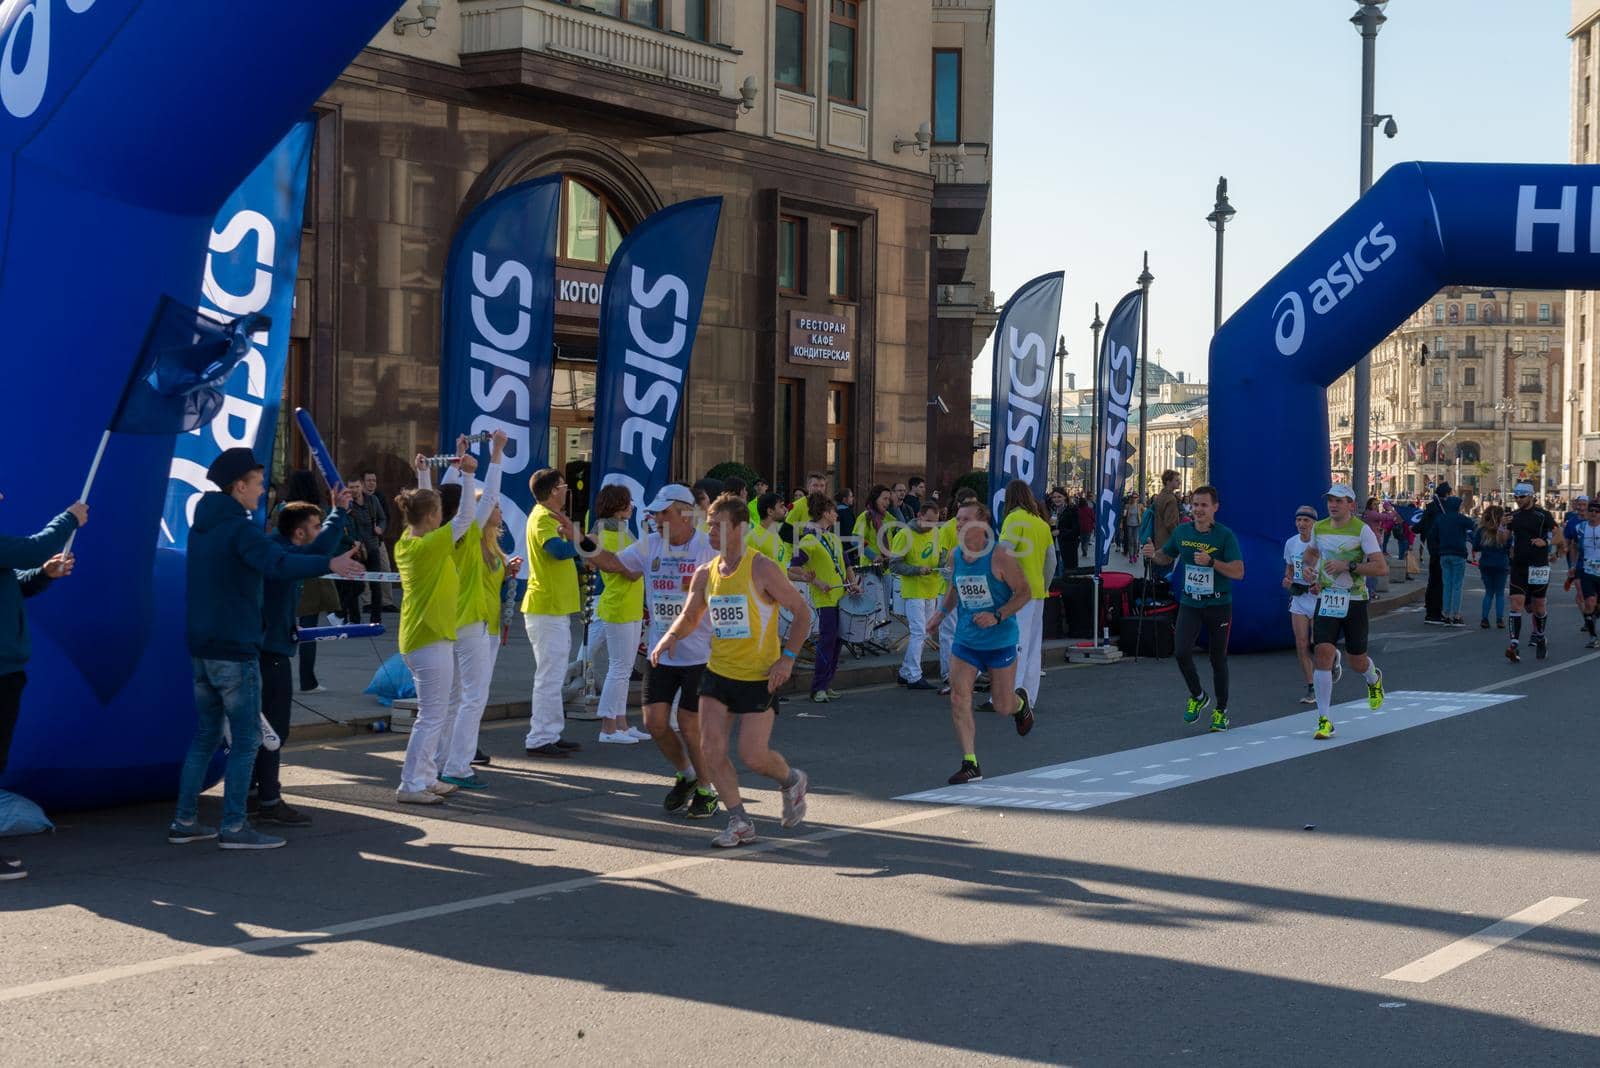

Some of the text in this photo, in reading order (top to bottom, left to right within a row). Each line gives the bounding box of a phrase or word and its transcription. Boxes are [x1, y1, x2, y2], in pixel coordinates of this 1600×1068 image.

[800, 318, 846, 333] РЕСТОРАН
[811, 333, 834, 346] КАФЕ
[794, 345, 850, 361] КОНДИТЕРСКАЯ
[1187, 572, 1209, 584] 4421
[960, 584, 986, 595] 3884
[1324, 595, 1345, 606] 7111
[654, 602, 682, 616] 3880
[712, 606, 744, 621] 3885
